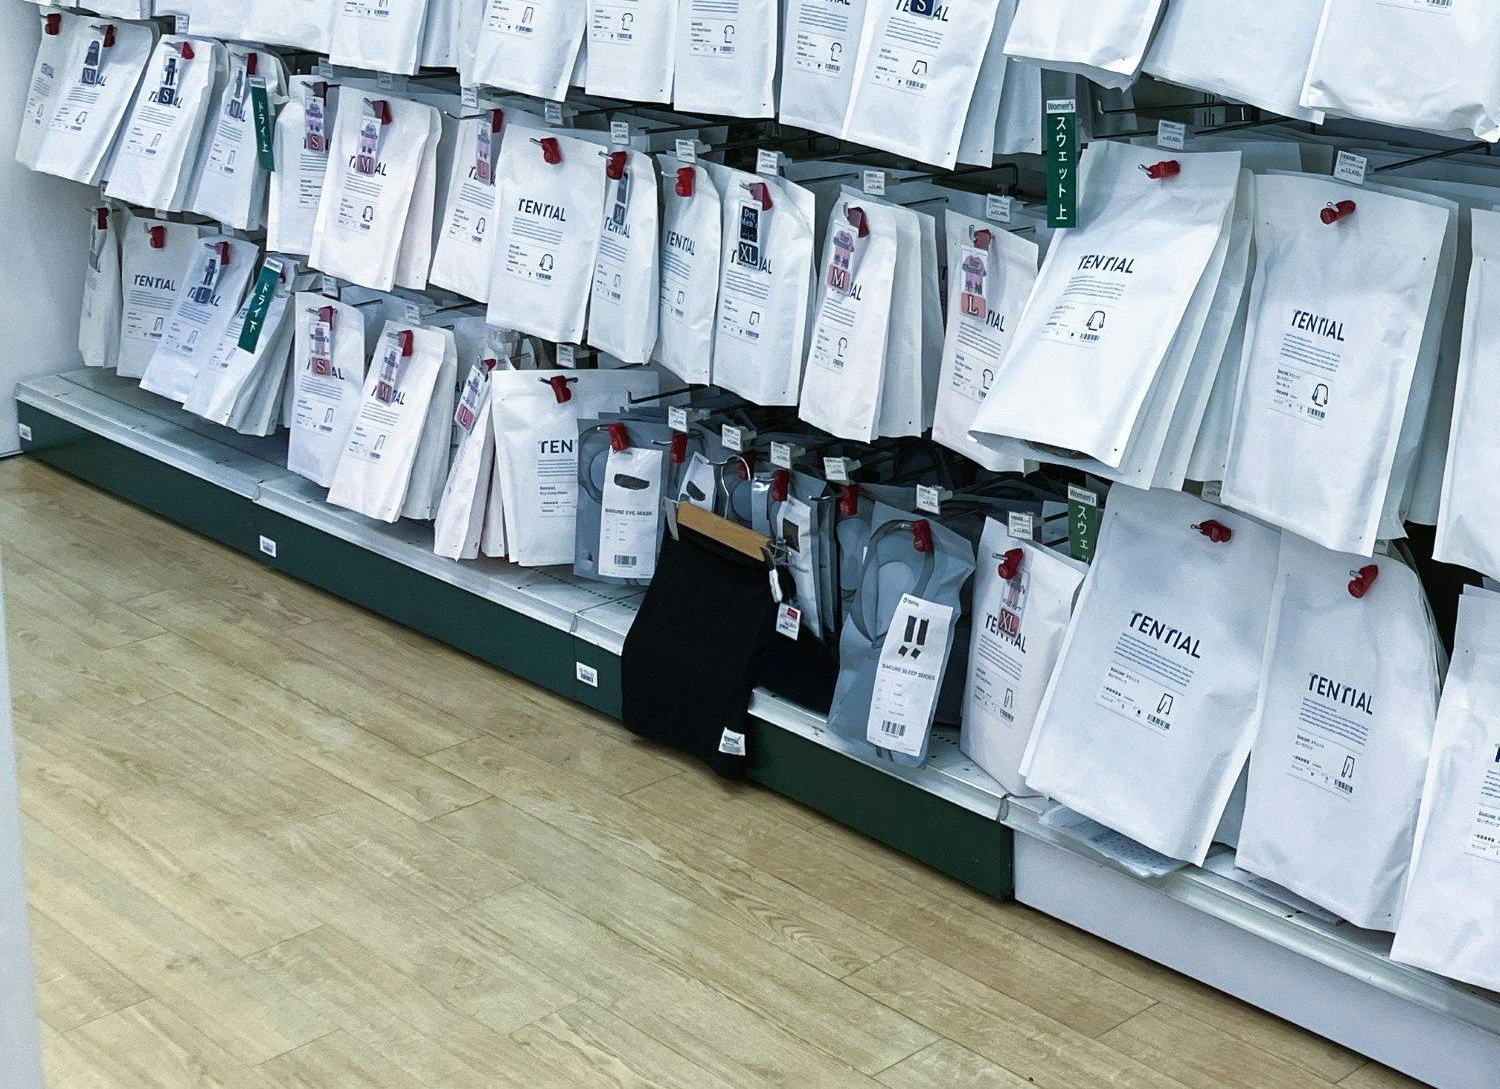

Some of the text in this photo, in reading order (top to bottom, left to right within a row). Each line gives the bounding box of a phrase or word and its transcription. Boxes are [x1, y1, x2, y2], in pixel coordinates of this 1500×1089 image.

[161, 89, 171, 103] S
[1047, 101, 1074, 111] Women's
[311, 135, 320, 149] S
[358, 156, 373, 172] M
[1055, 116, 1069, 222] スウェット上
[518, 198, 566, 222] TENTIAL
[665, 230, 695, 257] TENTIAL
[739, 245, 757, 264] XL
[1078, 254, 1134, 274] TENTIAL
[133, 274, 176, 292] TENTIAL
[831, 270, 846, 288] M
[967, 295, 979, 315] L
[1291, 309, 1345, 342] TENTIAL
[316, 358, 326, 373] S
[1001, 610, 1015, 634] XL
[1128, 611, 1203, 659] TENTIAL
[1308, 672, 1374, 716] TENTIAL
